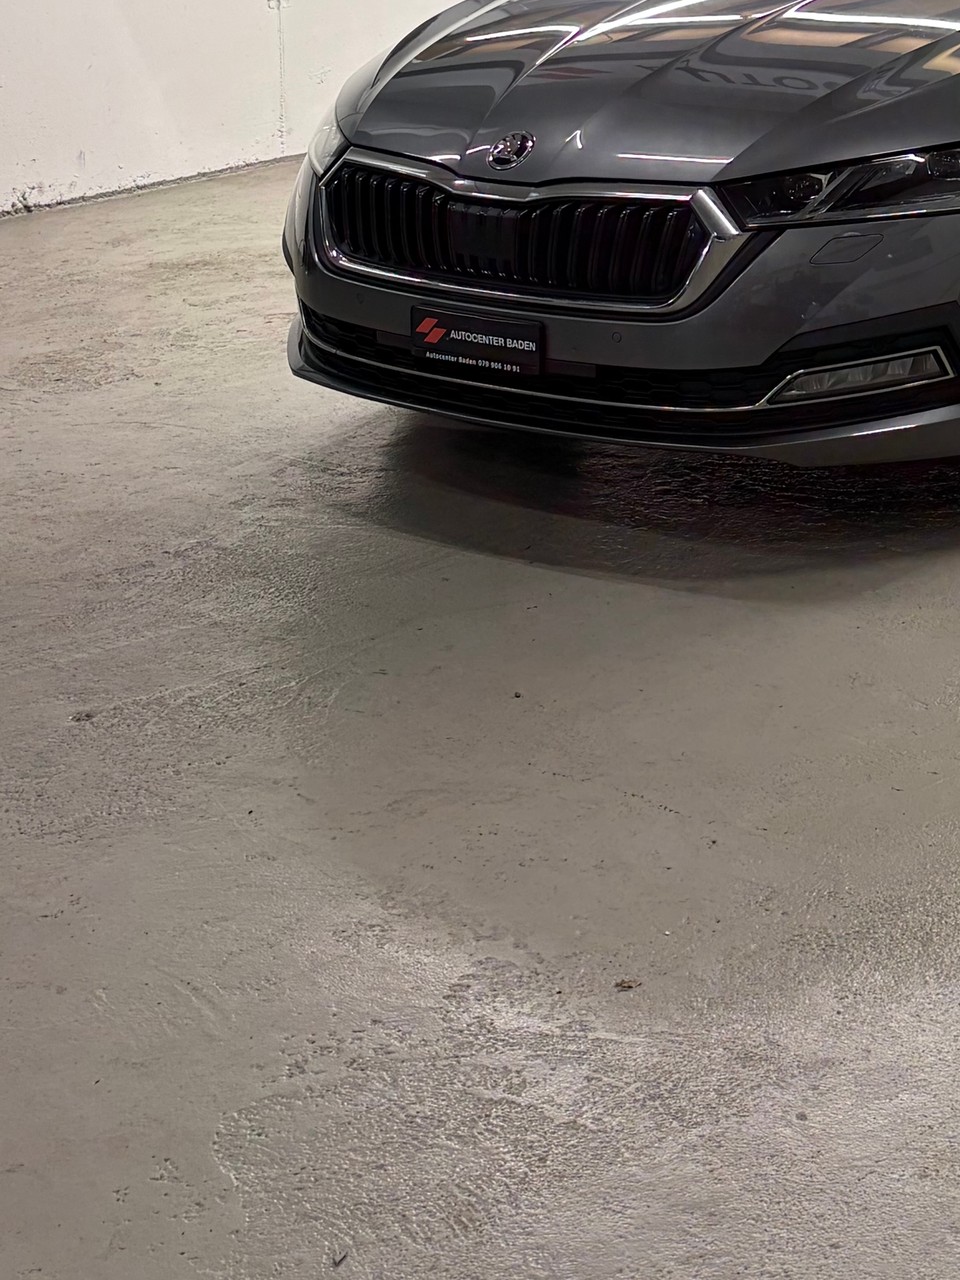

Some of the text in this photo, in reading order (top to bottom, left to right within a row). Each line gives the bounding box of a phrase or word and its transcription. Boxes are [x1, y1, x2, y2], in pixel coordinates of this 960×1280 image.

[450, 330, 536, 351] AUTOCENTER BADEN
[426, 351, 457, 362] Autocenter
[458, 356, 476, 365] Baden
[478, 359, 489, 368] 079
[503, 363, 512, 371] 10
